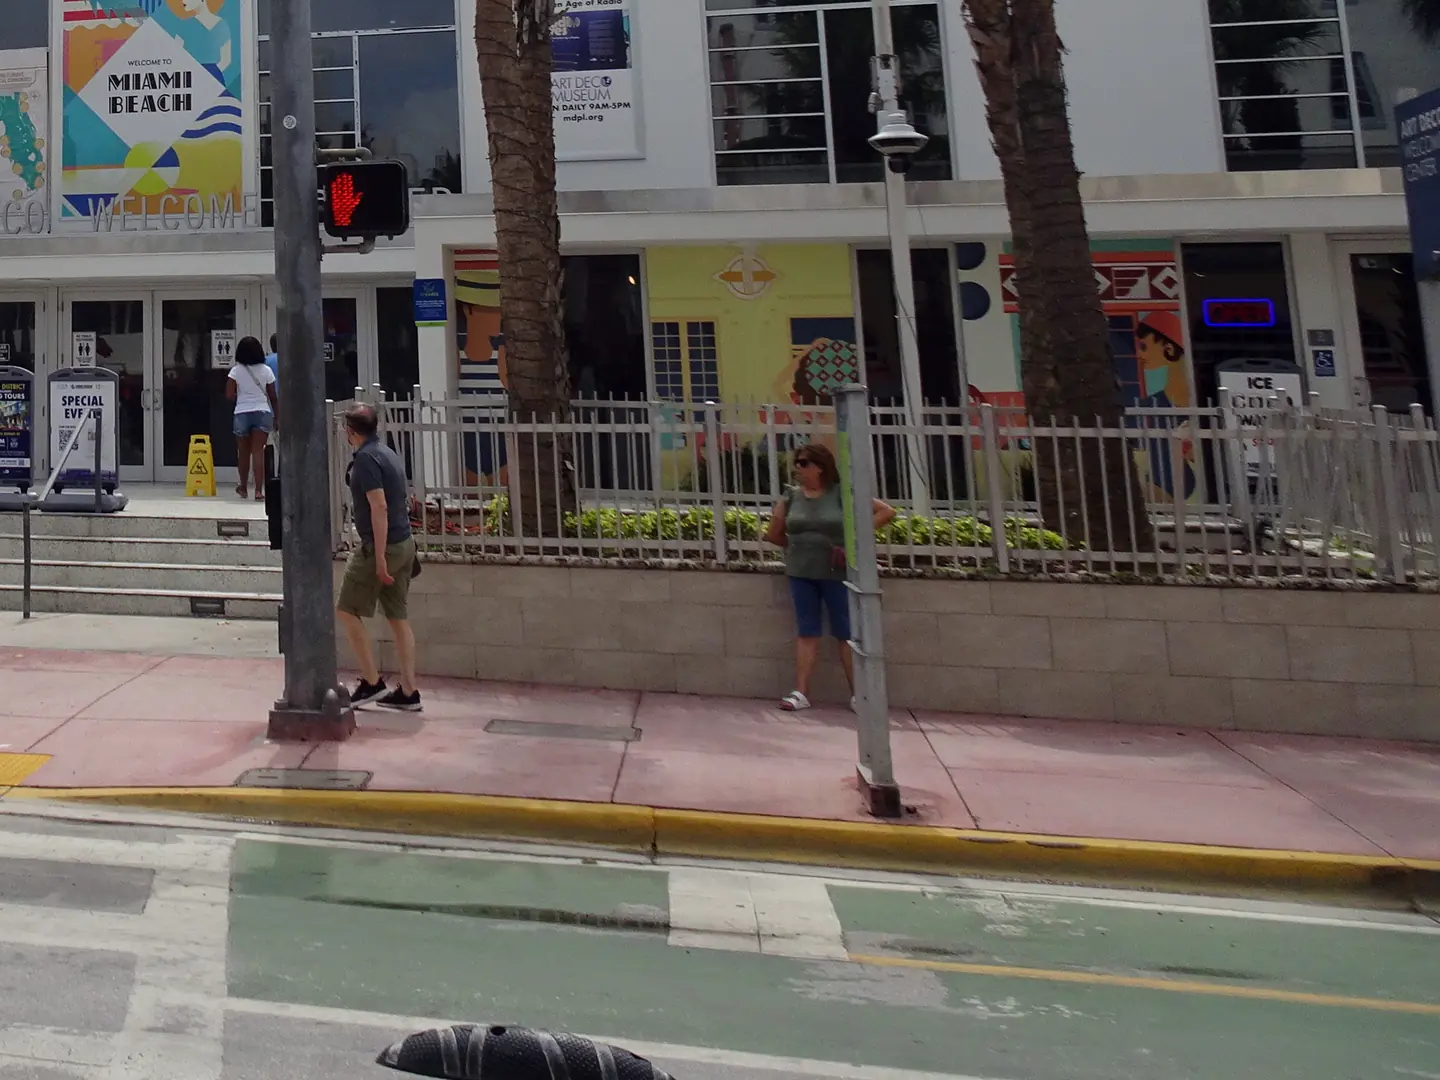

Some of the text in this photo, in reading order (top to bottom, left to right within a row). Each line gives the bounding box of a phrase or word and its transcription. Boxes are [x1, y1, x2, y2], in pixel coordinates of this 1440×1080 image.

[128, 59, 161, 67] WELCOME
[108, 71, 192, 92] MIAMI
[552, 88, 611, 102] MUSEUM
[108, 93, 192, 114] BEACH
[563, 114, 603, 122] mdpl.org
[88, 191, 260, 233] WELCOME
[1247, 377, 1274, 390] ICE
[61, 395, 104, 406] SPECIAL
